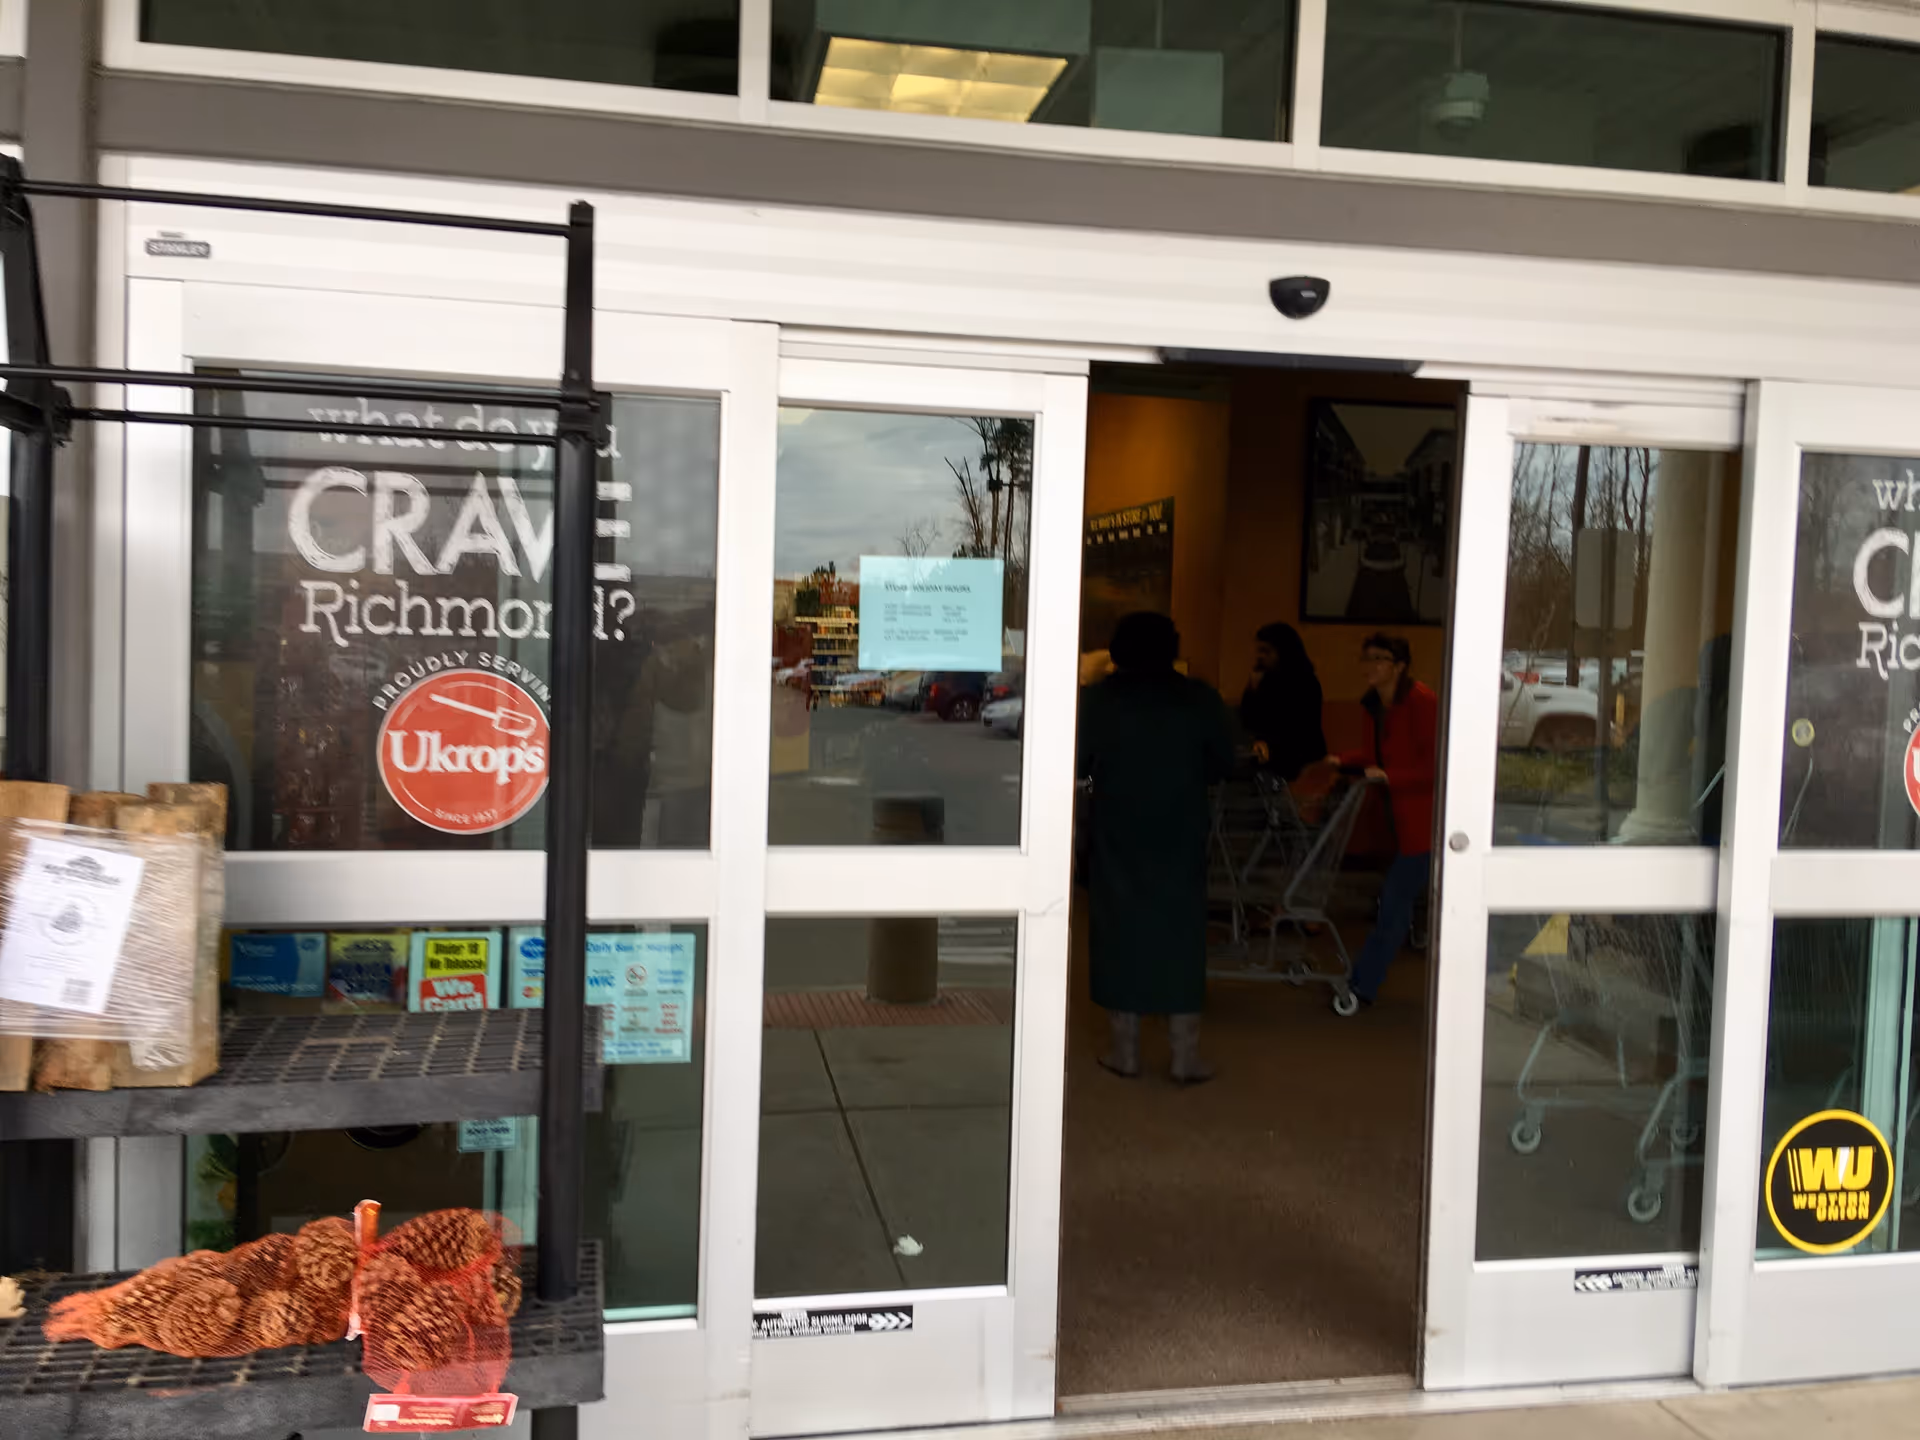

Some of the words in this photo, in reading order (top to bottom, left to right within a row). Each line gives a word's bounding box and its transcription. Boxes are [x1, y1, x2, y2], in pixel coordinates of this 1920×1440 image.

[307, 397, 443, 449] what
[455, 404, 518, 452] do
[372, 650, 468, 711] PROUDLY
[478, 652, 551, 702] SERVIN
[387, 729, 545, 786] Ukrop's
[431, 978, 475, 998] We
[1788, 1146, 1873, 1191] WU
[1793, 1191, 1870, 1210] WESTERN
[1816, 1204, 1869, 1222] UNION
[845, 1312, 868, 1326] DOOR
